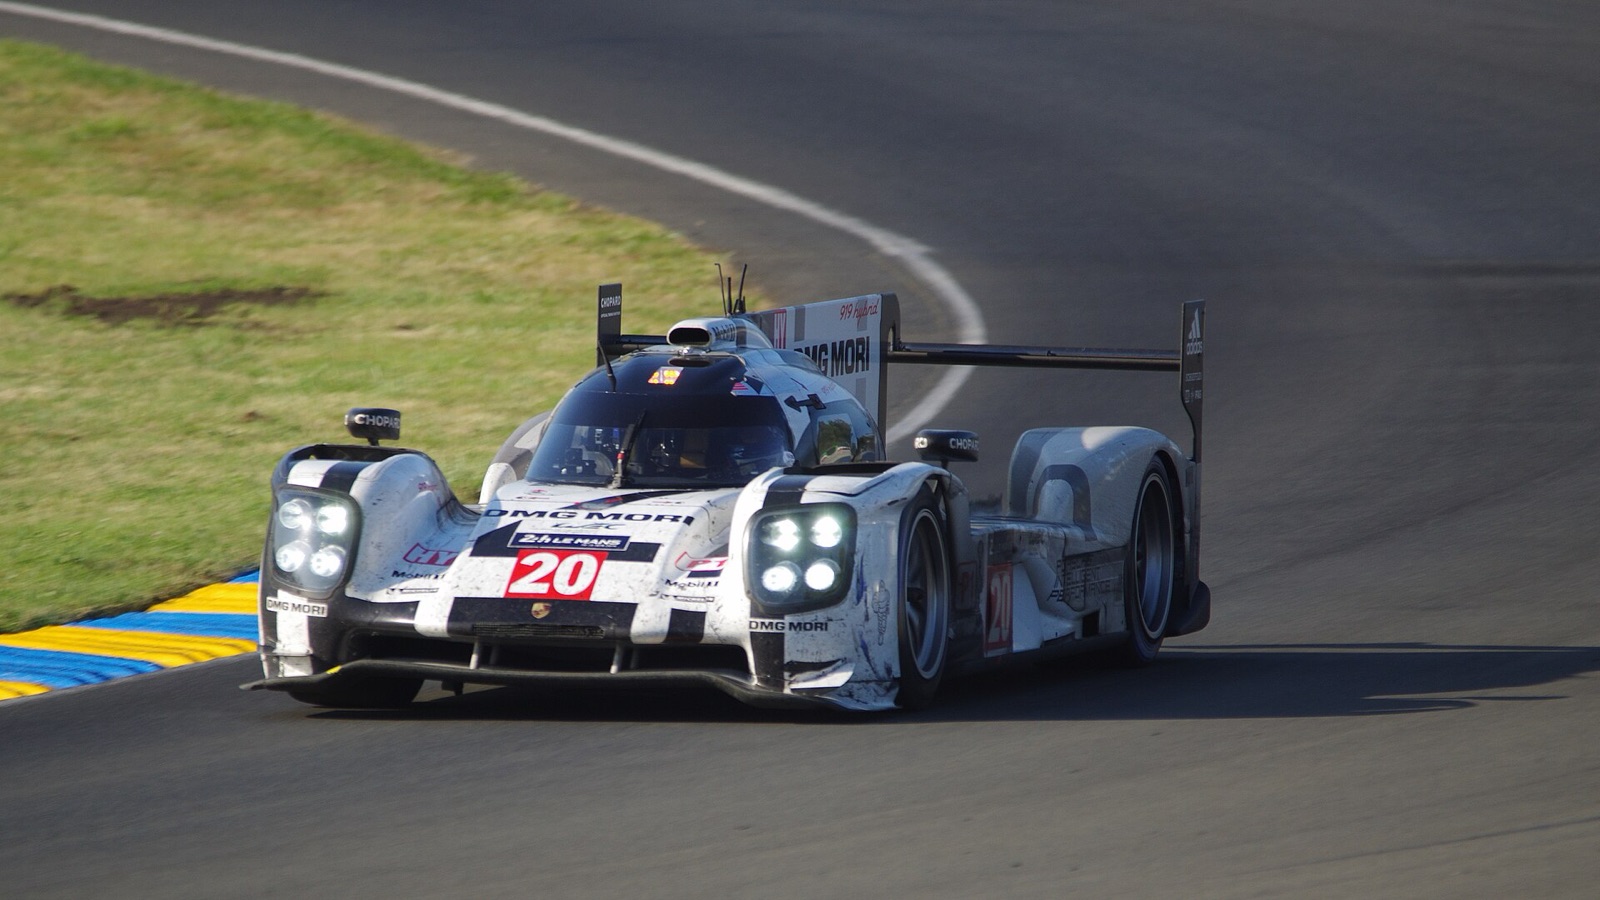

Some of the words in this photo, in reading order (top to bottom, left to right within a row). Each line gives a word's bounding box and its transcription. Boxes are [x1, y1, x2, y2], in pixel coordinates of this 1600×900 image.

[601, 296, 621, 308] CHOPARD
[840, 303, 853, 320] 919
[853, 298, 880, 328] hybrid
[831, 336, 870, 377] MORI
[484, 509, 578, 519] DMG
[585, 512, 696, 526] MORI
[574, 538, 622, 546] MANS
[508, 552, 600, 596] 20
[665, 579, 705, 588] Mobil
[267, 599, 289, 611] DMG
[291, 602, 326, 616] MORI
[988, 571, 1011, 643] 20
[749, 621, 786, 631] DMG
[788, 622, 829, 632] MORI
